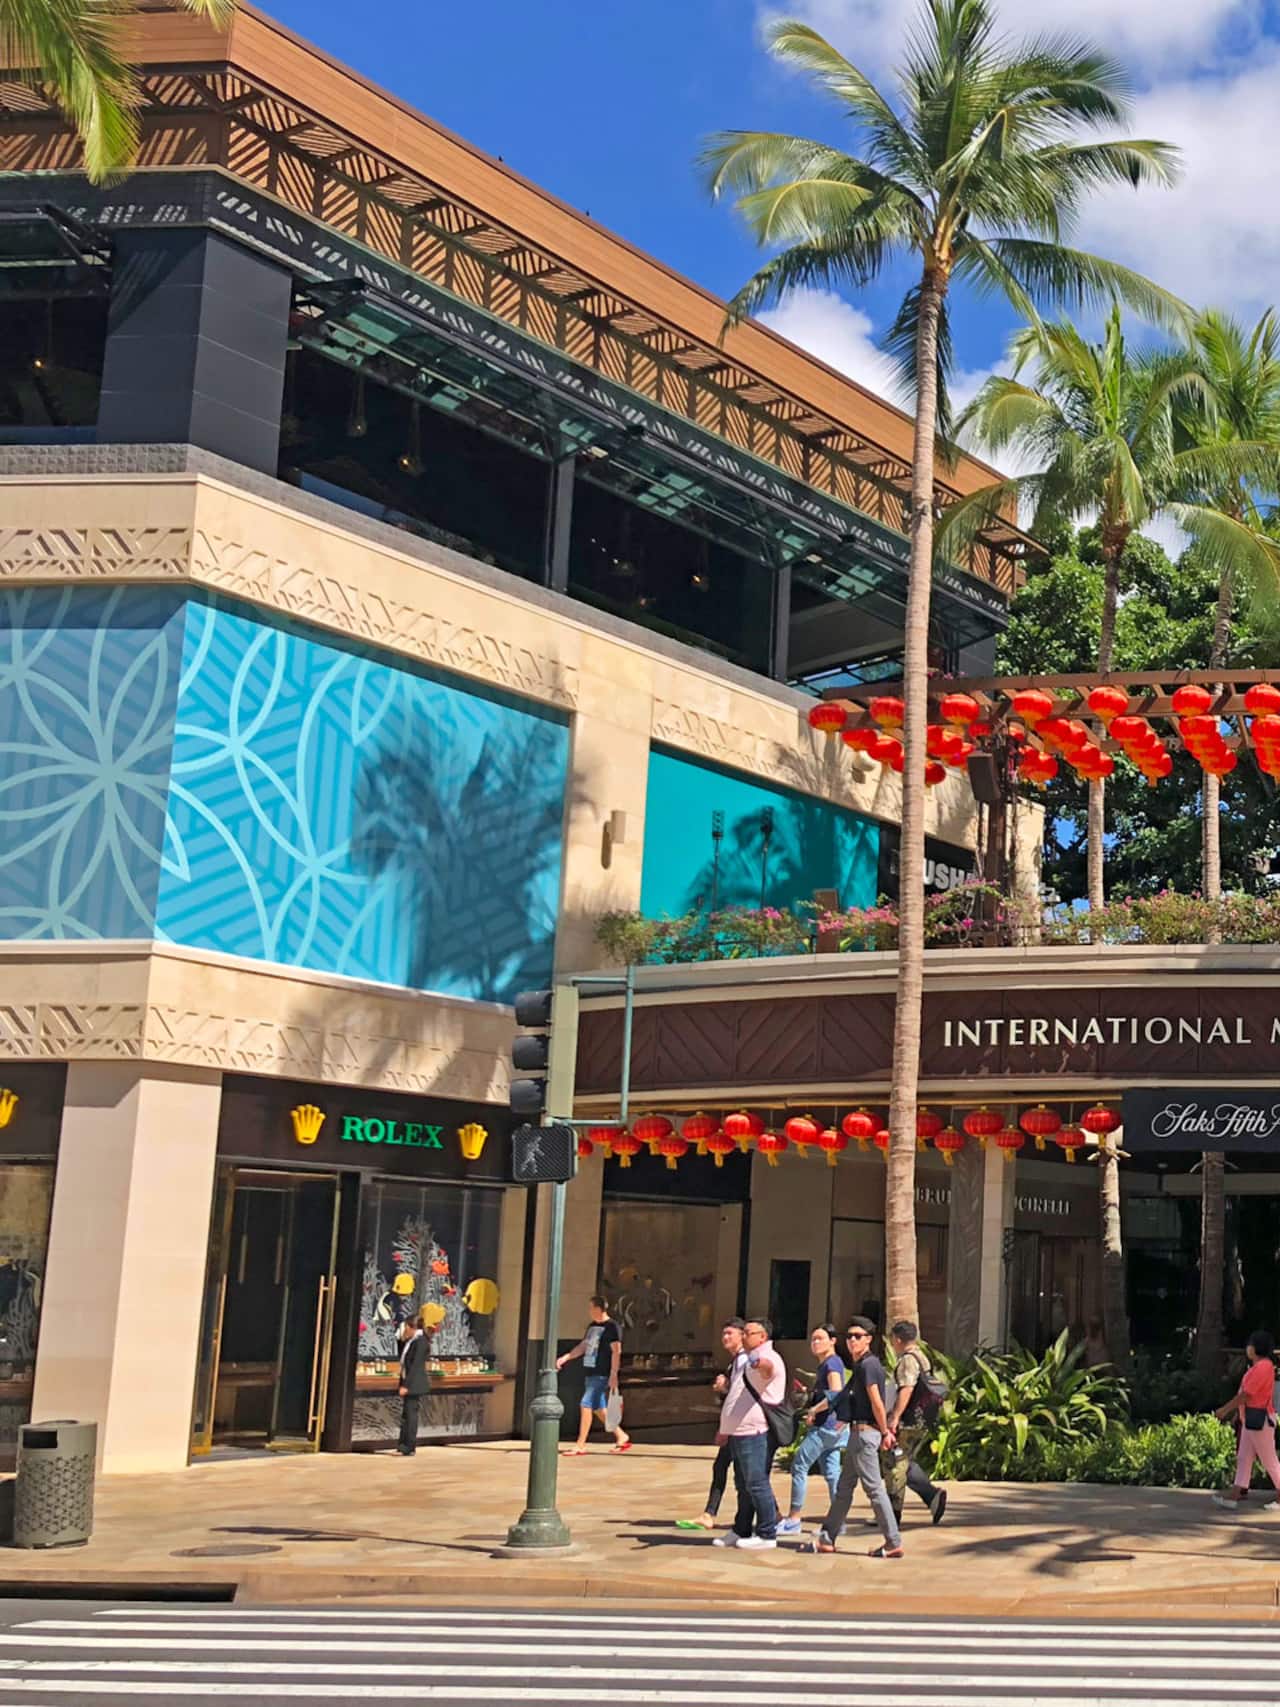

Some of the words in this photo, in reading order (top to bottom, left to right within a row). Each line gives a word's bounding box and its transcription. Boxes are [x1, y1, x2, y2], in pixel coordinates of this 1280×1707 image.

[943, 1017, 1252, 1047] INTERNATIONAL
[341, 1115, 444, 1149] ROLEX
[1151, 1103, 1216, 1138] Saks
[1207, 1103, 1267, 1138] Fifth
